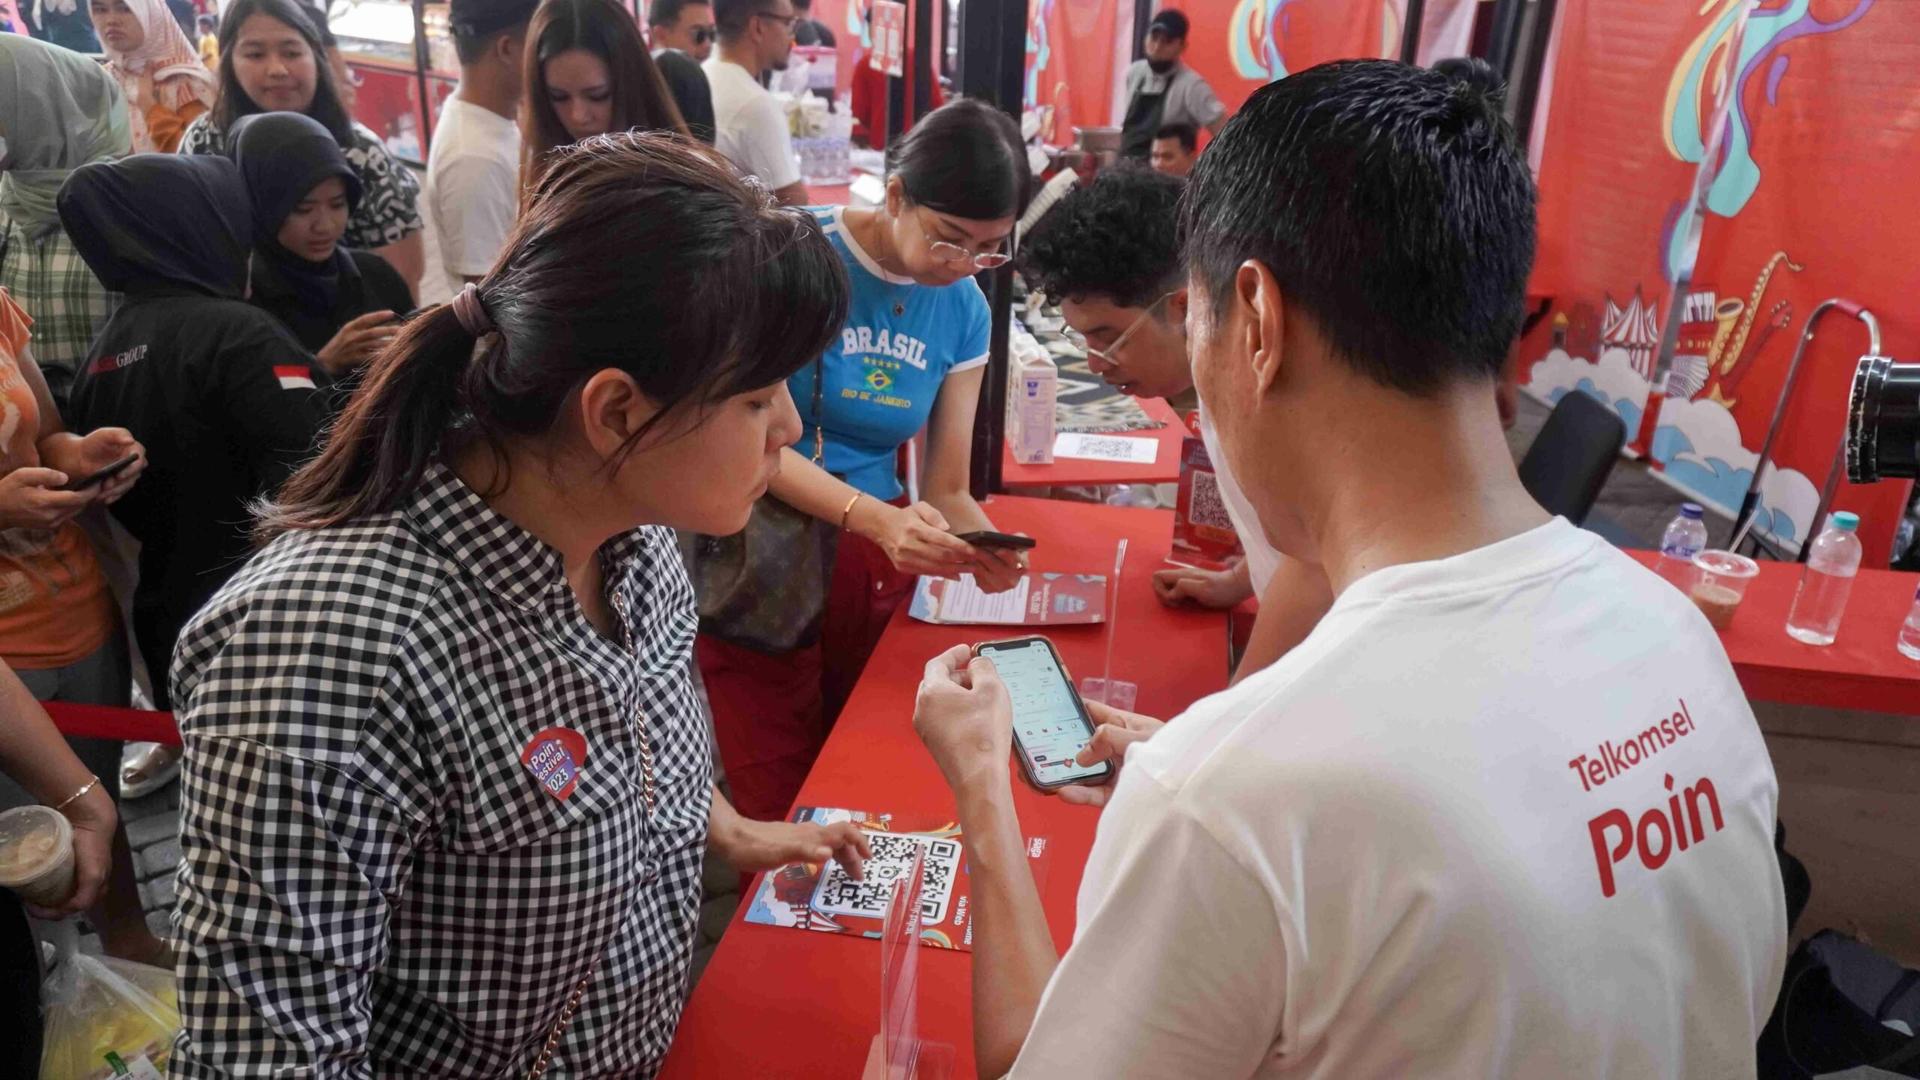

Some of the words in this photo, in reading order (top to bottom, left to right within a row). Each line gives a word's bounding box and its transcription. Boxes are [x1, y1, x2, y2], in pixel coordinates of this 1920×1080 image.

[842, 326, 927, 370] BRASIL
[531, 743, 554, 770] Poin
[1568, 698, 1696, 792] Telkomsel
[1587, 773, 1725, 898] Poin
